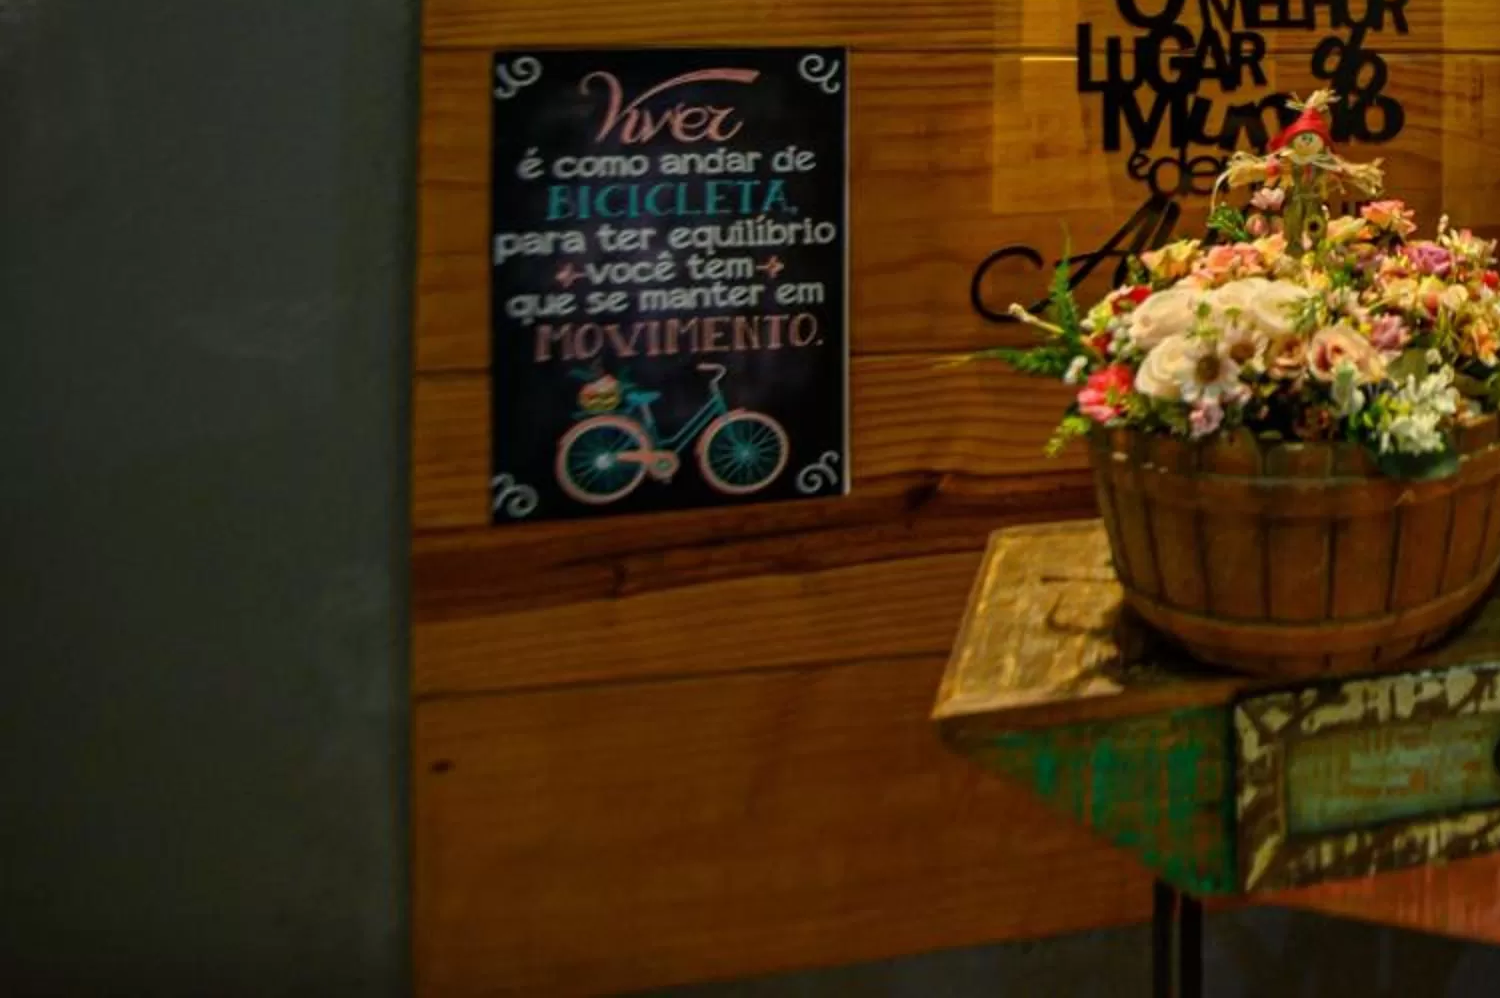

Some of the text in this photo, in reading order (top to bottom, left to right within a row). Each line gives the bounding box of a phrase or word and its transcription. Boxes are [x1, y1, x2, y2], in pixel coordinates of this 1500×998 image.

[1076, 21, 1268, 94] LUGAR
[579, 67, 761, 145] Viver
[517, 145, 817, 180] é como andar de
[493, 216, 837, 266] para ter equilíbrio
[585, 252, 754, 284] você tem
[506, 281, 825, 325] que se manter em
